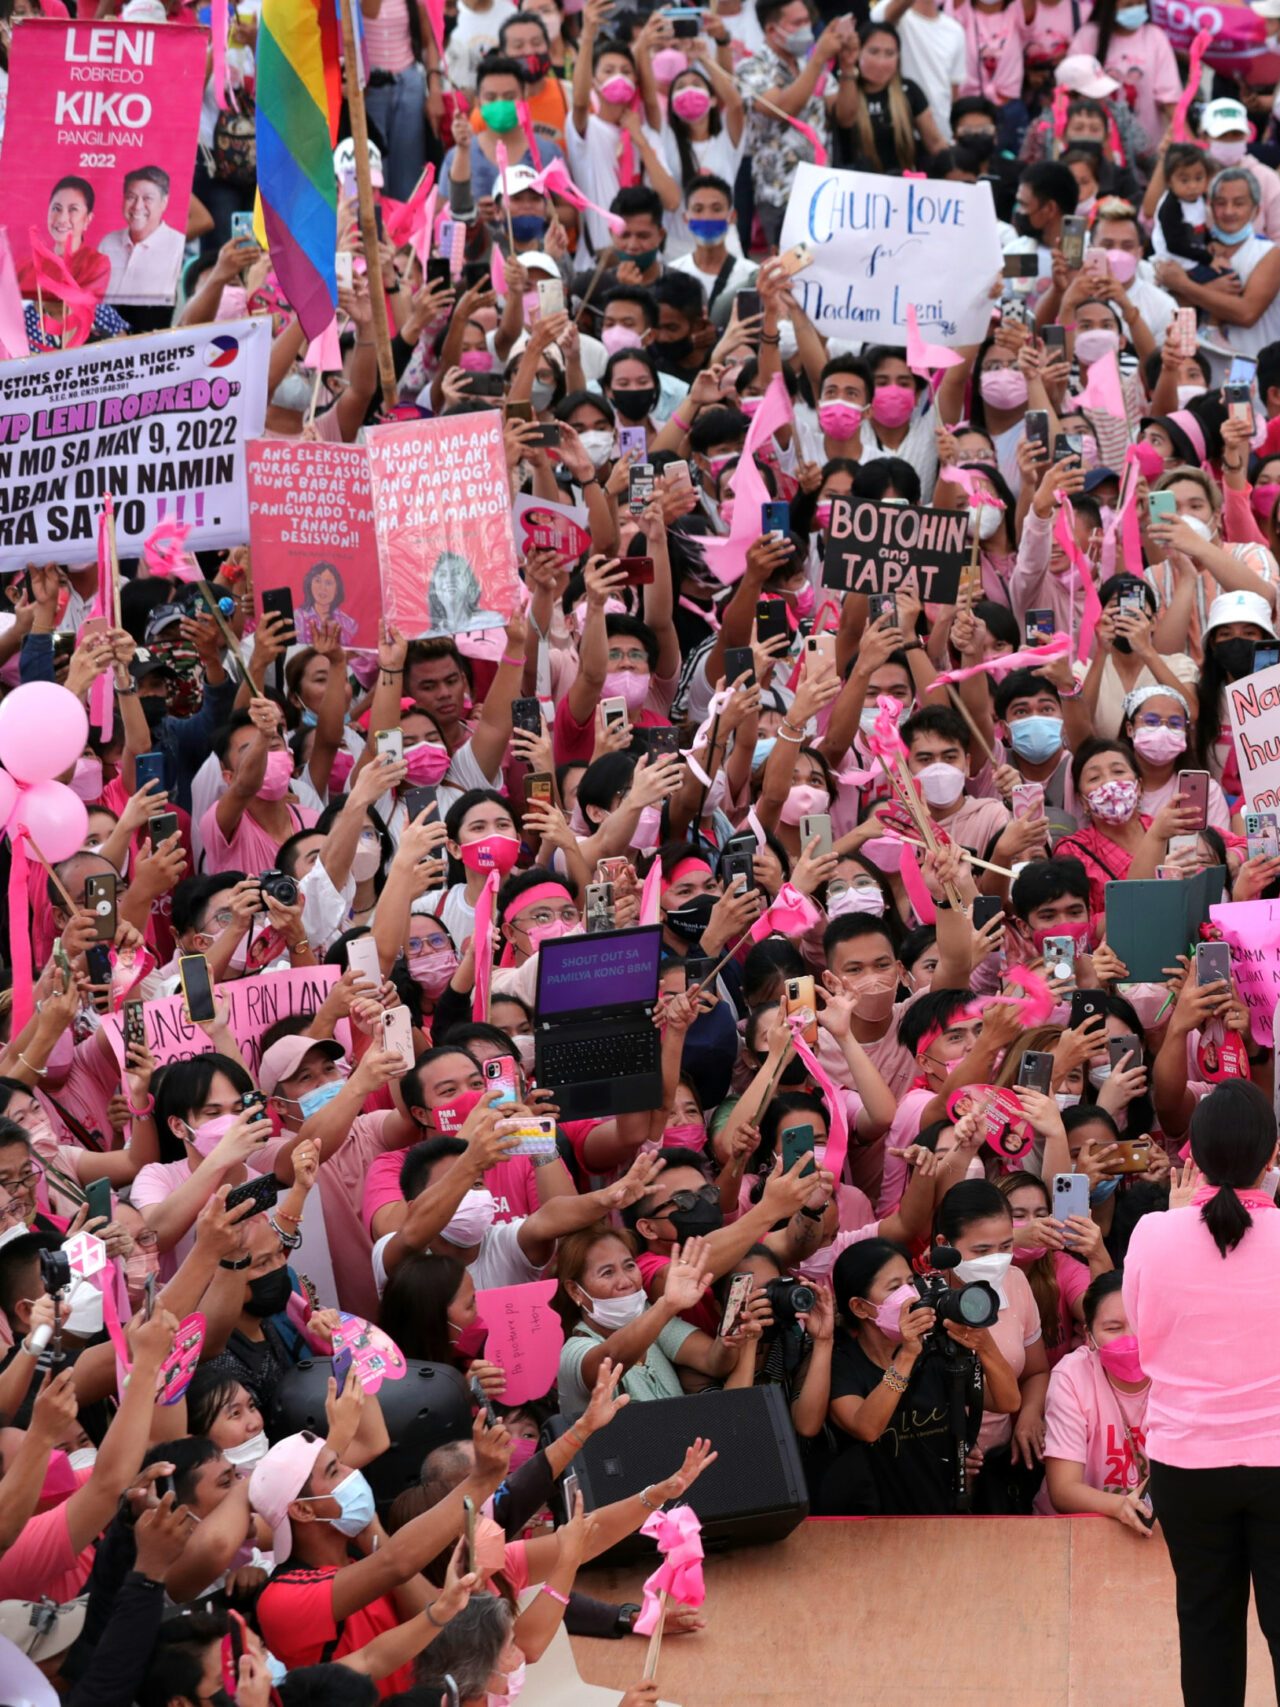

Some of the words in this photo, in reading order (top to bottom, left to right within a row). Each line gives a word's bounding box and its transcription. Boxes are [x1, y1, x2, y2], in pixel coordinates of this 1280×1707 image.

[64, 27, 155, 66] LENI
[70, 67, 144, 84] ROBREDO
[54, 91, 152, 128] KIKO
[57, 130, 143, 147] PANGILINAN
[79, 153, 115, 167] 2022
[0, 372, 50, 390] ICTIMS
[55, 367, 73, 381] OF
[78, 355, 134, 378] HUMAN
[140, 345, 195, 366] RIGHTS
[4, 376, 100, 400] VIOLATIONS
[149, 362, 180, 376] INC.
[32, 401, 98, 441] LENI
[19, 445, 56, 477] MO
[61, 440, 90, 469] SA
[95, 425, 142, 459] MAY
[149, 422, 170, 455] 9,
[176, 416, 237, 452] 2022
[369, 440, 433, 460] UNSAON
[440, 429, 500, 453] NALANG
[262, 448, 292, 460] ANG
[297, 449, 369, 467] ELEKSYON
[386, 455, 429, 474] KUNG
[434, 448, 488, 468] LALAKI
[249, 462, 301, 475] MURAG
[306, 464, 370, 479] RELASYO
[381, 475, 412, 493] ANG
[418, 463, 492, 488] MADAOG?
[0, 476, 68, 514] ABAN
[137, 454, 234, 494] NAMIN
[254, 474, 294, 489] KUNG
[299, 477, 346, 492] BABAE
[352, 481, 370, 495] AN
[250, 501, 342, 518] PANIGURADO
[379, 495, 398, 511] SA
[403, 490, 436, 509] UNA
[442, 487, 462, 503] RA
[291, 517, 348, 533] TANANG
[378, 514, 399, 533] NA
[405, 509, 439, 527] SILA
[831, 500, 967, 553] BOTOHIN
[281, 530, 360, 548] DESISYON!!
[879, 547, 909, 565] ang
[842, 553, 939, 599] TAPAT
[561, 955, 597, 968] SHOUT
[601, 950, 623, 962] OUT
[625, 948, 639, 959] SA
[547, 971, 591, 985] PAMILYA
[594, 966, 624, 978] KONG
[627, 962, 652, 973] BBM
[973, 1361, 982, 1390] ONY
